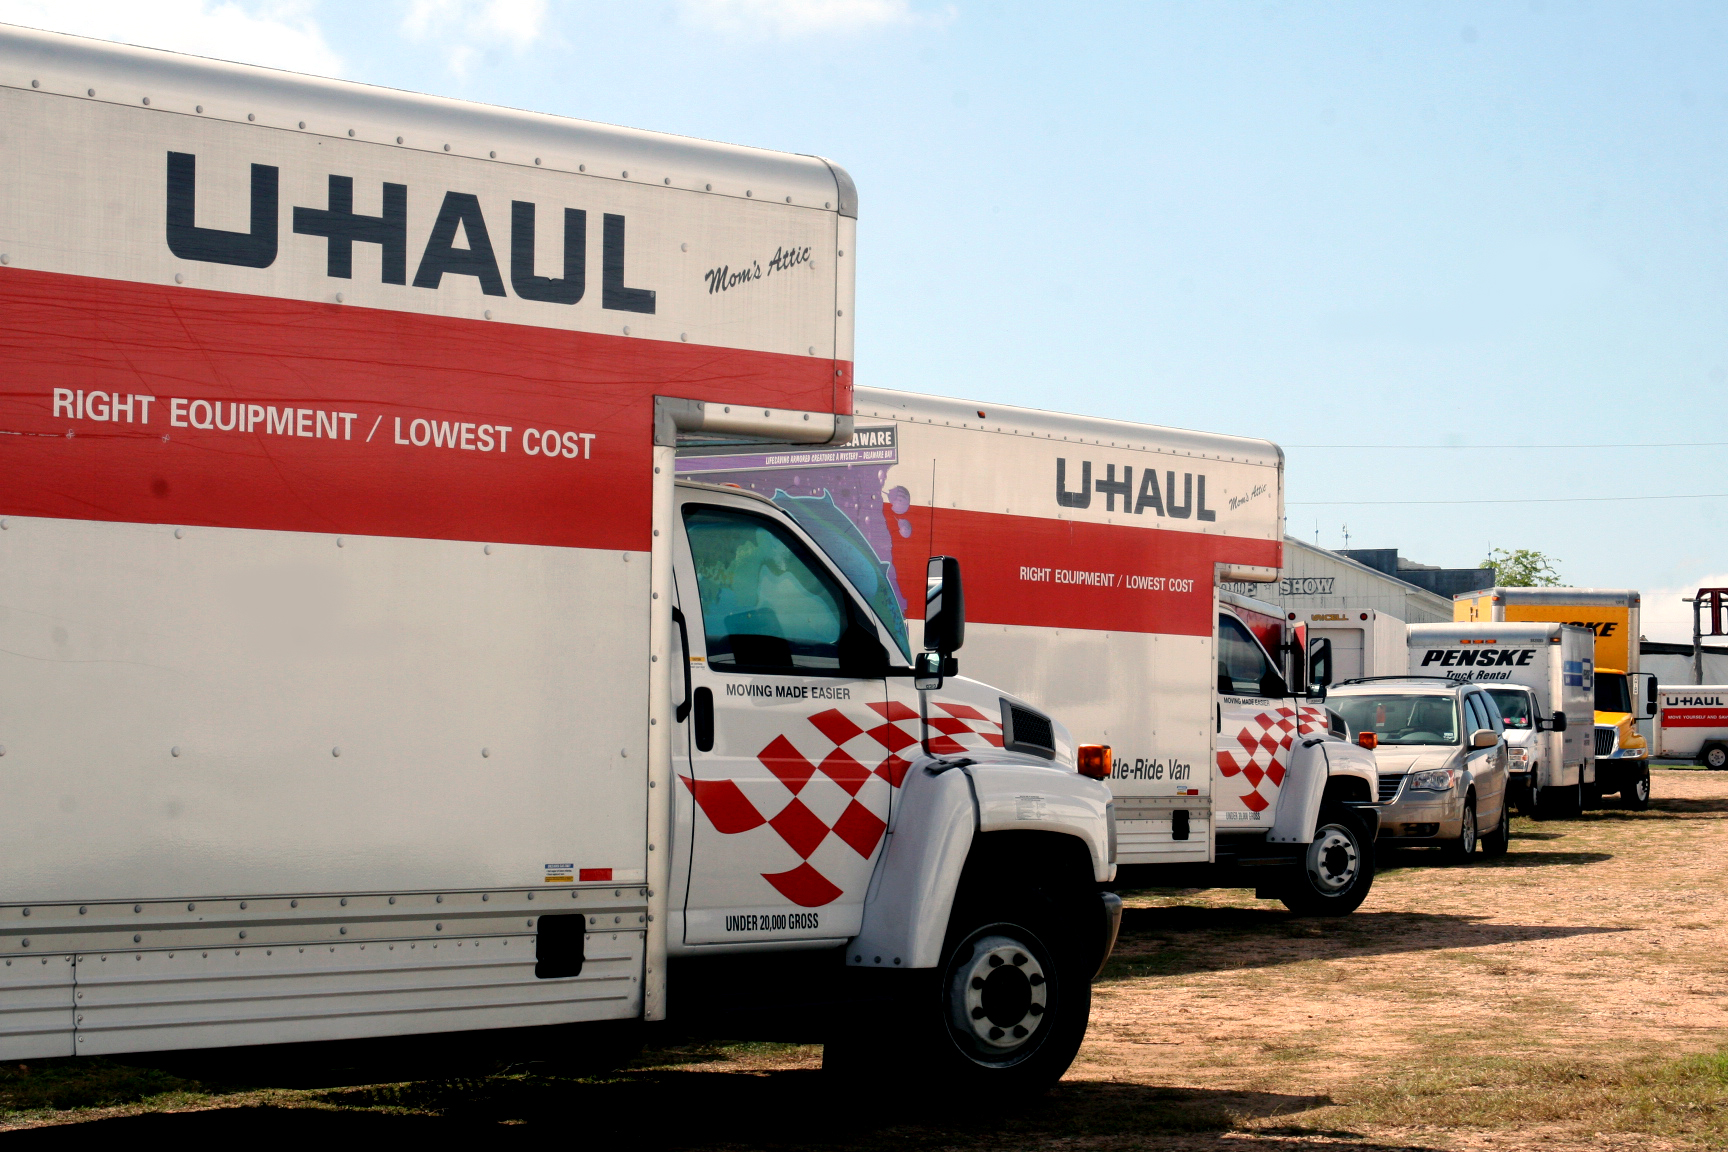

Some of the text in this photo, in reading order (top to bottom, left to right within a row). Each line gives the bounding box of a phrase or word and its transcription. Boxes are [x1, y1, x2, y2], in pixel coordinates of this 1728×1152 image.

[166, 151, 656, 314] U-HAUL
[704, 246, 811, 294] Mom's Attic
[52, 388, 596, 460] RIGHT EQUIPMENT / LOWEST COST
[840, 431, 892, 447] AWARE
[1056, 457, 1216, 522] U-HAUL
[1020, 566, 1051, 582] RIGHT
[1055, 569, 1115, 587] EQUIPMENT
[1126, 575, 1166, 591] LOWEST
[1169, 578, 1194, 592] COST
[1279, 577, 1335, 595] SHOW
[1421, 649, 1537, 666] PENSKE
[1446, 669, 1512, 680] Truck Rental
[726, 684, 851, 700] MOVING MADE EASIER
[1223, 697, 1241, 705] MOVING
[1242, 698, 1254, 706] MADE
[1666, 697, 1724, 706] U-HAUL
[1109, 758, 1191, 780] tle-Ride Van
[725, 913, 819, 932] UNDER 20,000 GROSS
